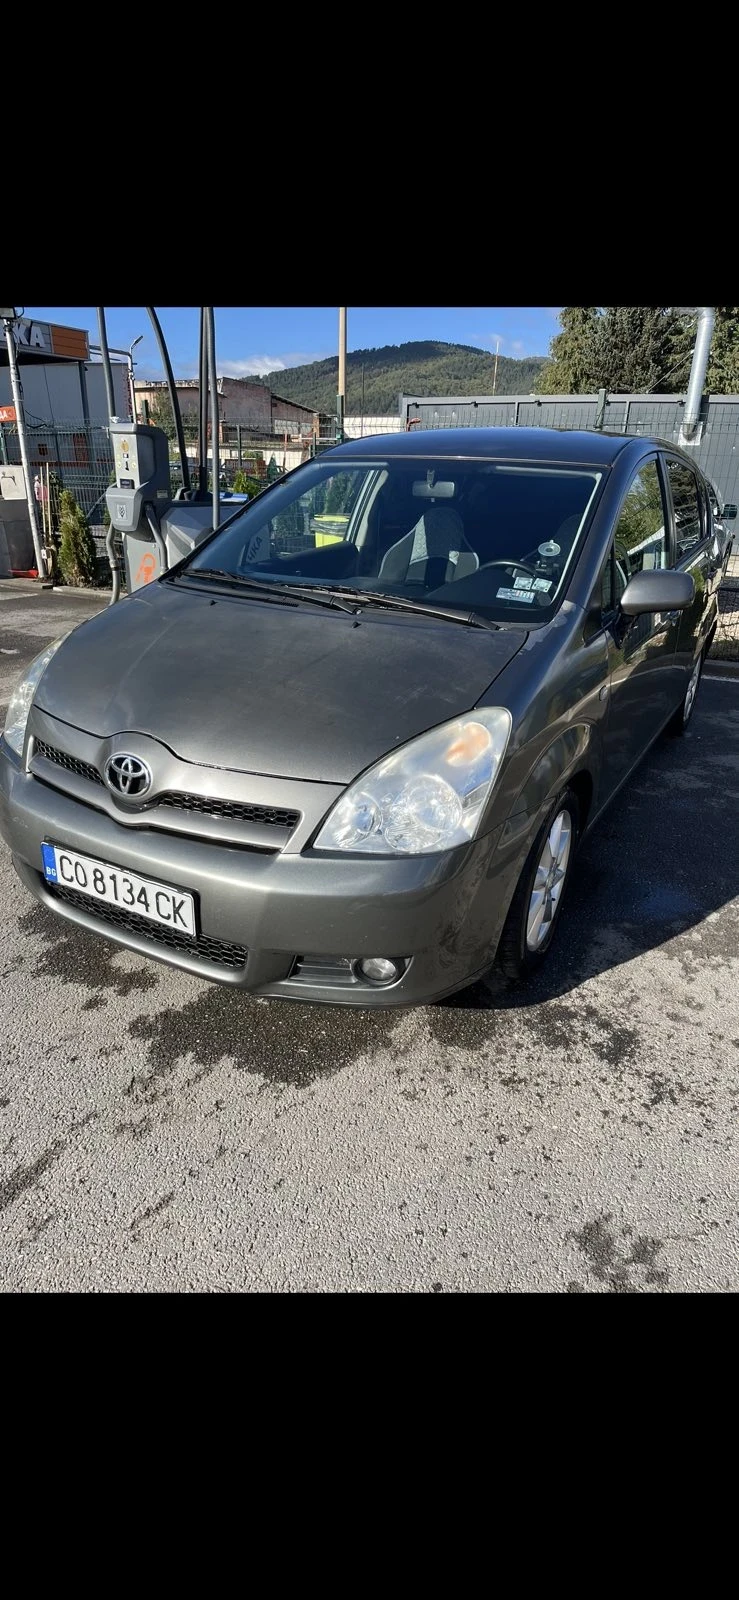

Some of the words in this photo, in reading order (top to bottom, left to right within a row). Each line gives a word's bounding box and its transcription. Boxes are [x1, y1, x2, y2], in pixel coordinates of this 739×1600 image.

[46, 866, 57, 877] BG
[93, 868, 150, 913] 8134
[155, 891, 188, 928] CK
